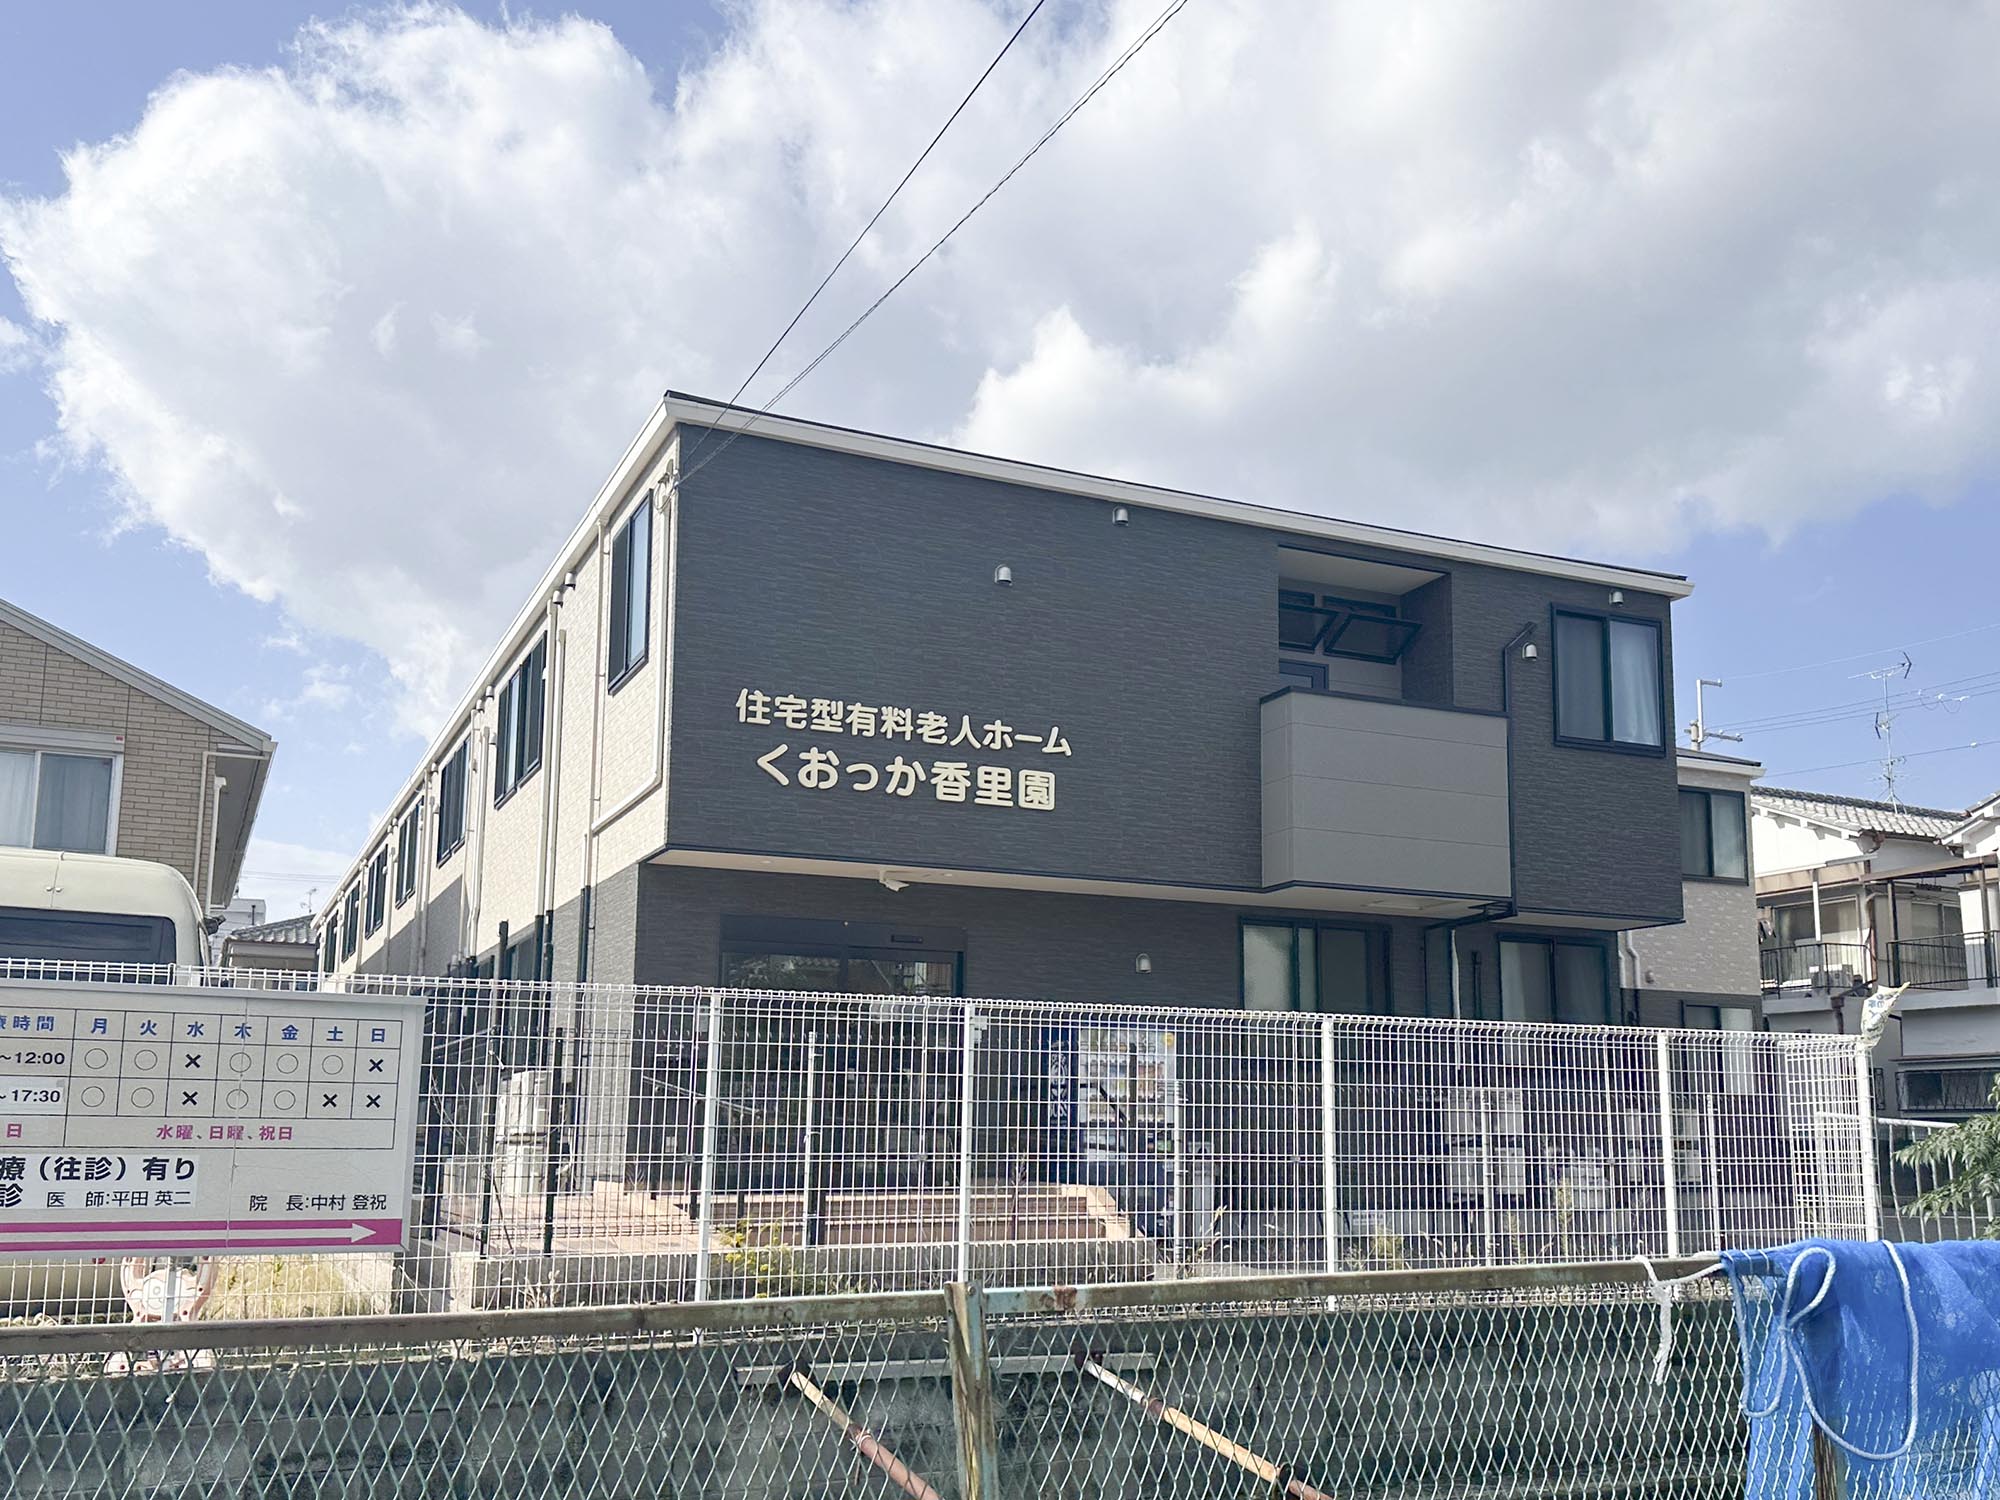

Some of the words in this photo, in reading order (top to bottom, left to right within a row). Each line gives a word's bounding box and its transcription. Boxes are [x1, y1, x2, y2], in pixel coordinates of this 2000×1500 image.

[735, 688, 1072, 757] 住宅型有料老人ホーム
[756, 743, 1056, 811] くおっか香里園
[91, 1018, 108, 1034] 月
[139, 1019, 157, 1036] 火
[187, 1021, 205, 1038] 水
[234, 1023, 252, 1039] 木
[281, 1024, 299, 1041] 金
[326, 1026, 344, 1042] 土
[371, 1028, 386, 1043] 日
